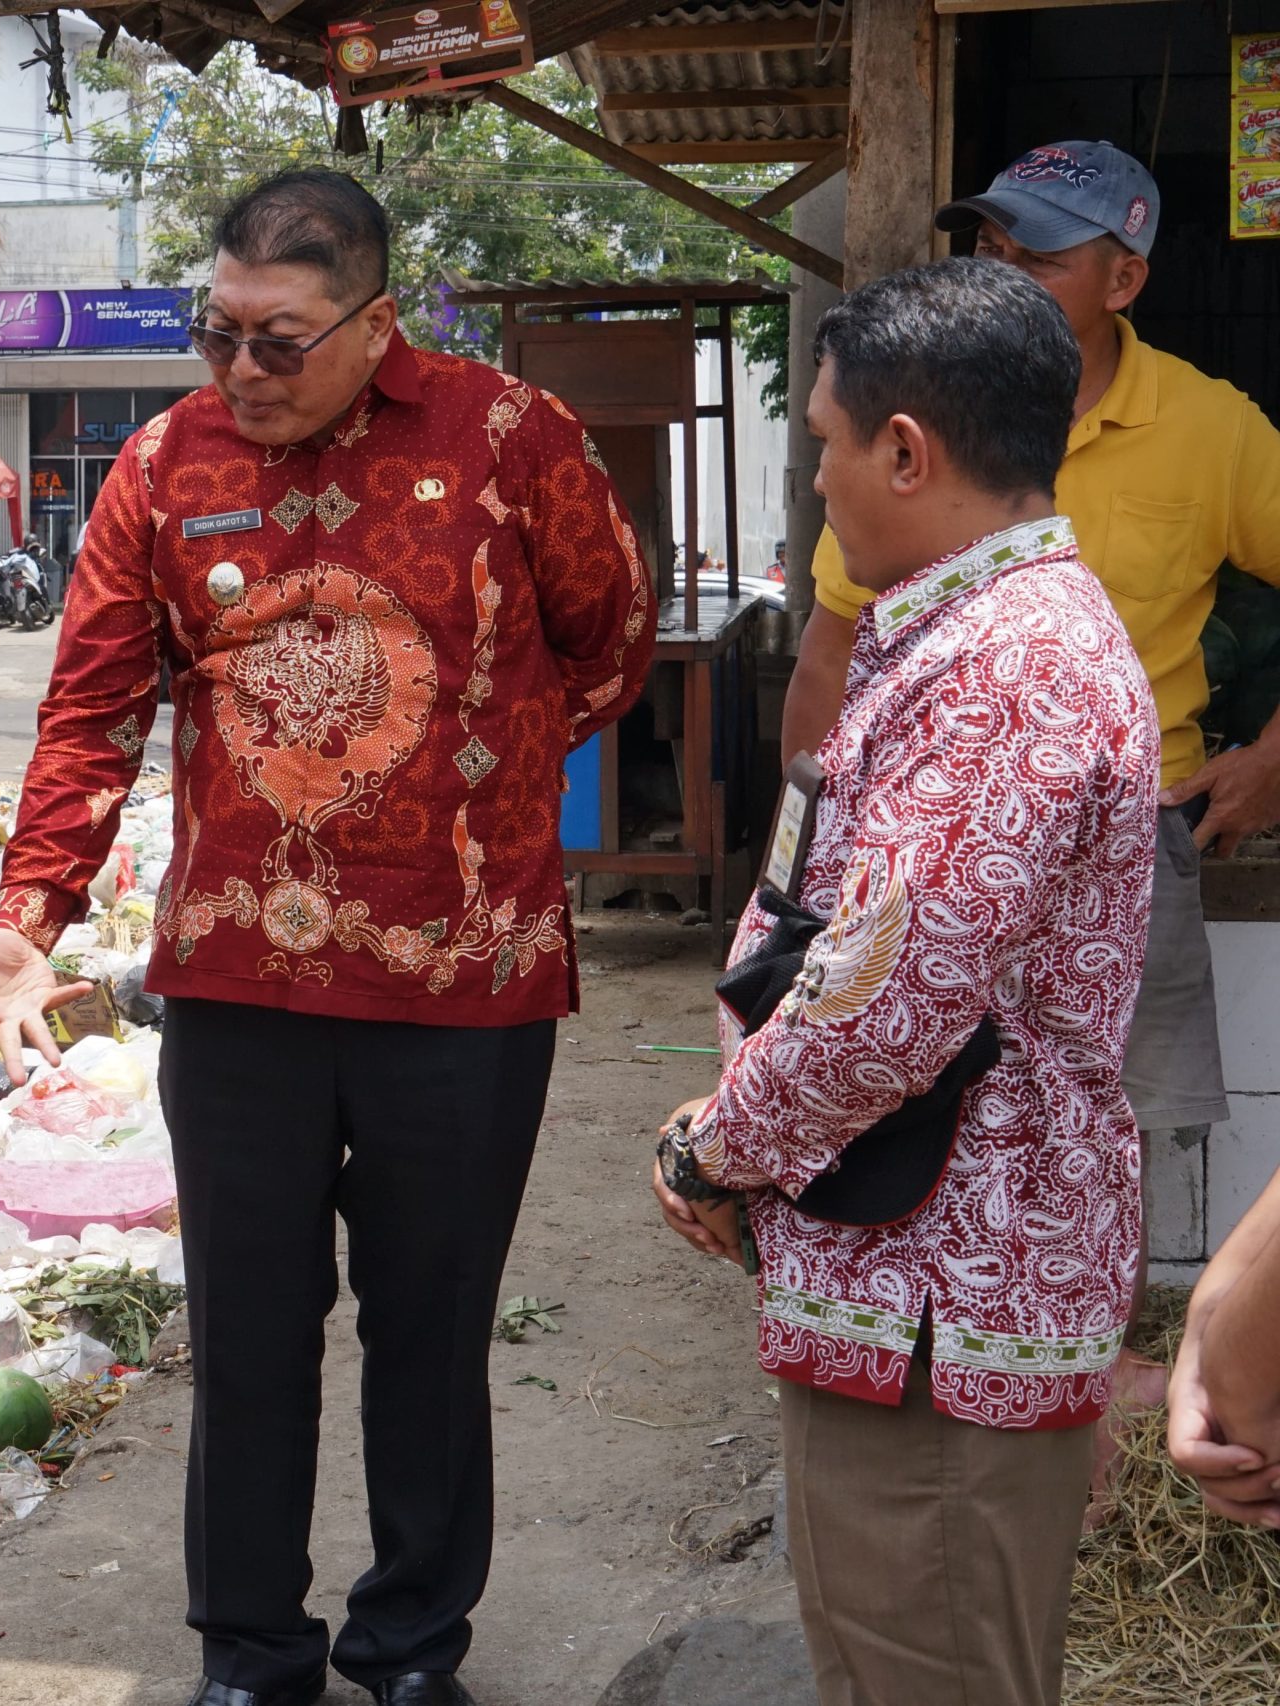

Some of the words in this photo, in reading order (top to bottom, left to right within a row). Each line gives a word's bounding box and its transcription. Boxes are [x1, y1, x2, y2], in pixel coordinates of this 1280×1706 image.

[392, 33, 430, 46] TEPUNG
[433, 26, 467, 39] BUMBU
[380, 32, 480, 61] BERVITAMIN
[83, 302, 93, 311] A
[96, 301, 128, 311] NEW
[96, 309, 171, 320] SENSATION
[140, 319, 159, 328] OF
[161, 319, 181, 328] ICE
[194, 520, 215, 531] DIDIK
[216, 516, 241, 528] GATOT
